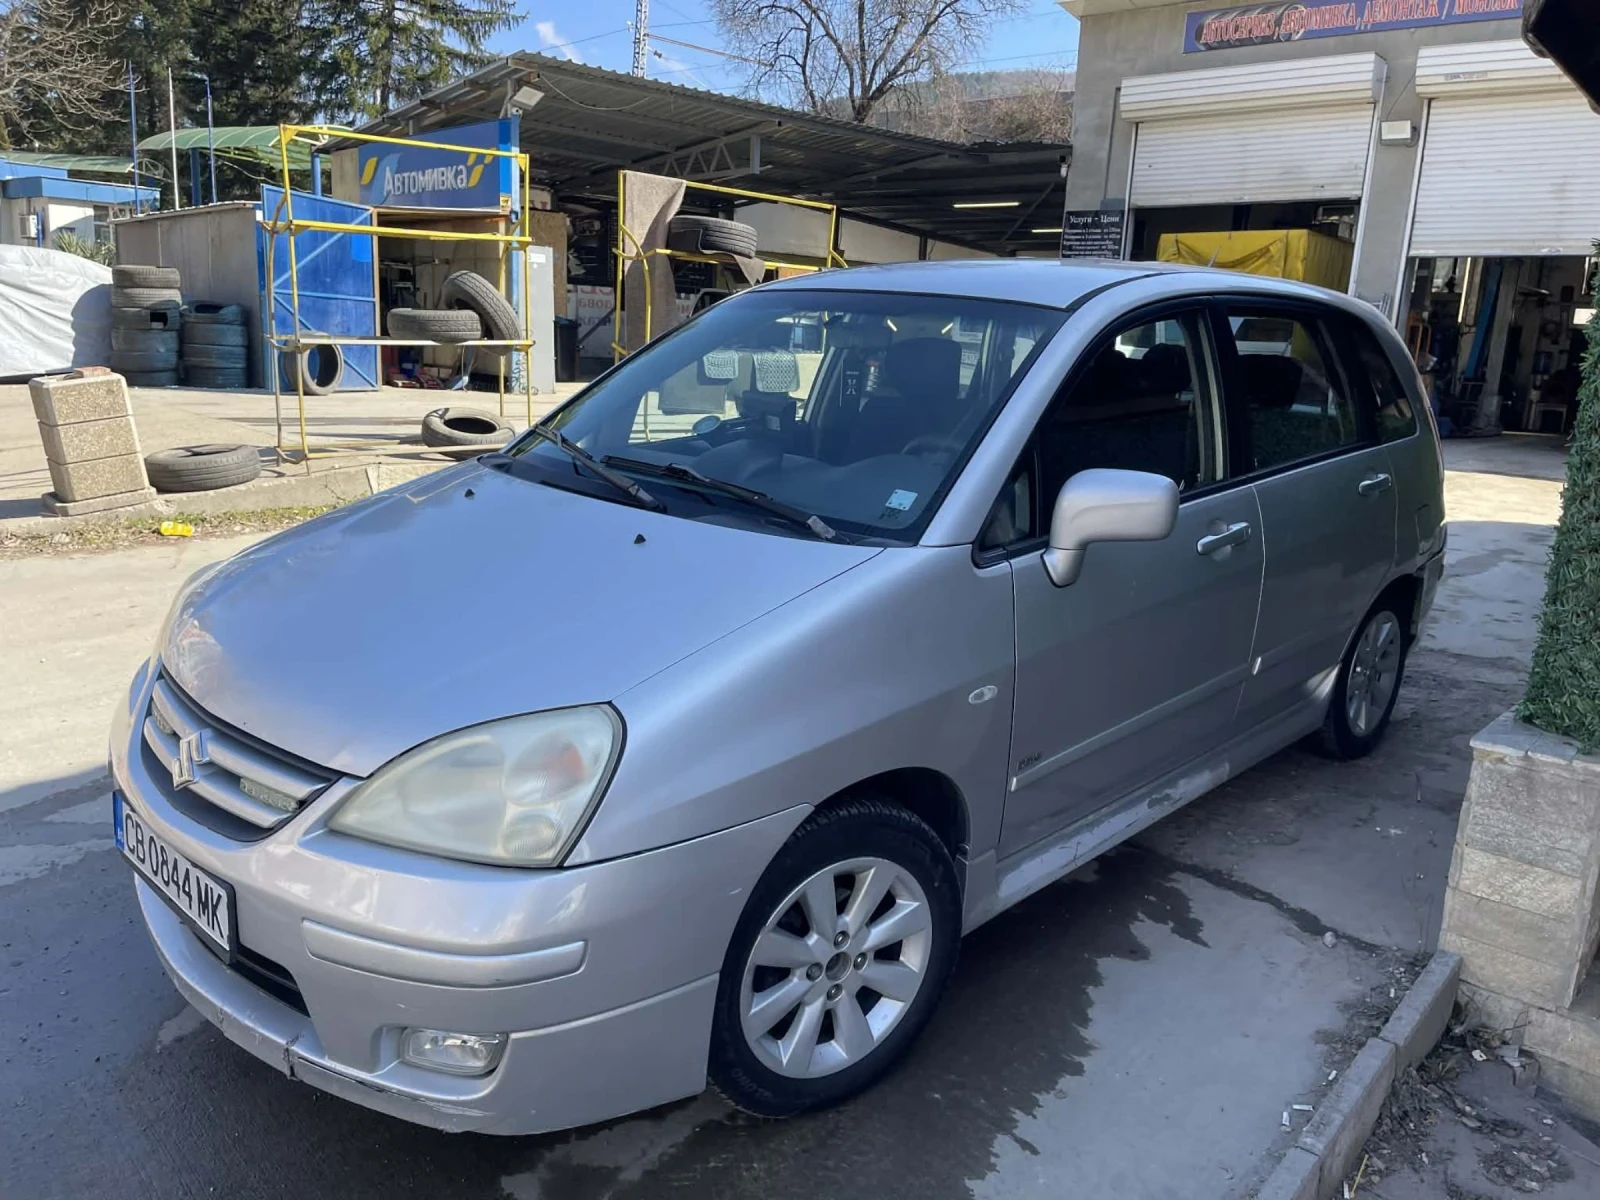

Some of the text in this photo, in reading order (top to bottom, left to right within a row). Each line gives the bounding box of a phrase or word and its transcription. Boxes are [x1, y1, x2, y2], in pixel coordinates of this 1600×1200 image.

[383, 164, 468, 196] Автомивка
[125, 813, 224, 939] CB 0844 MK
